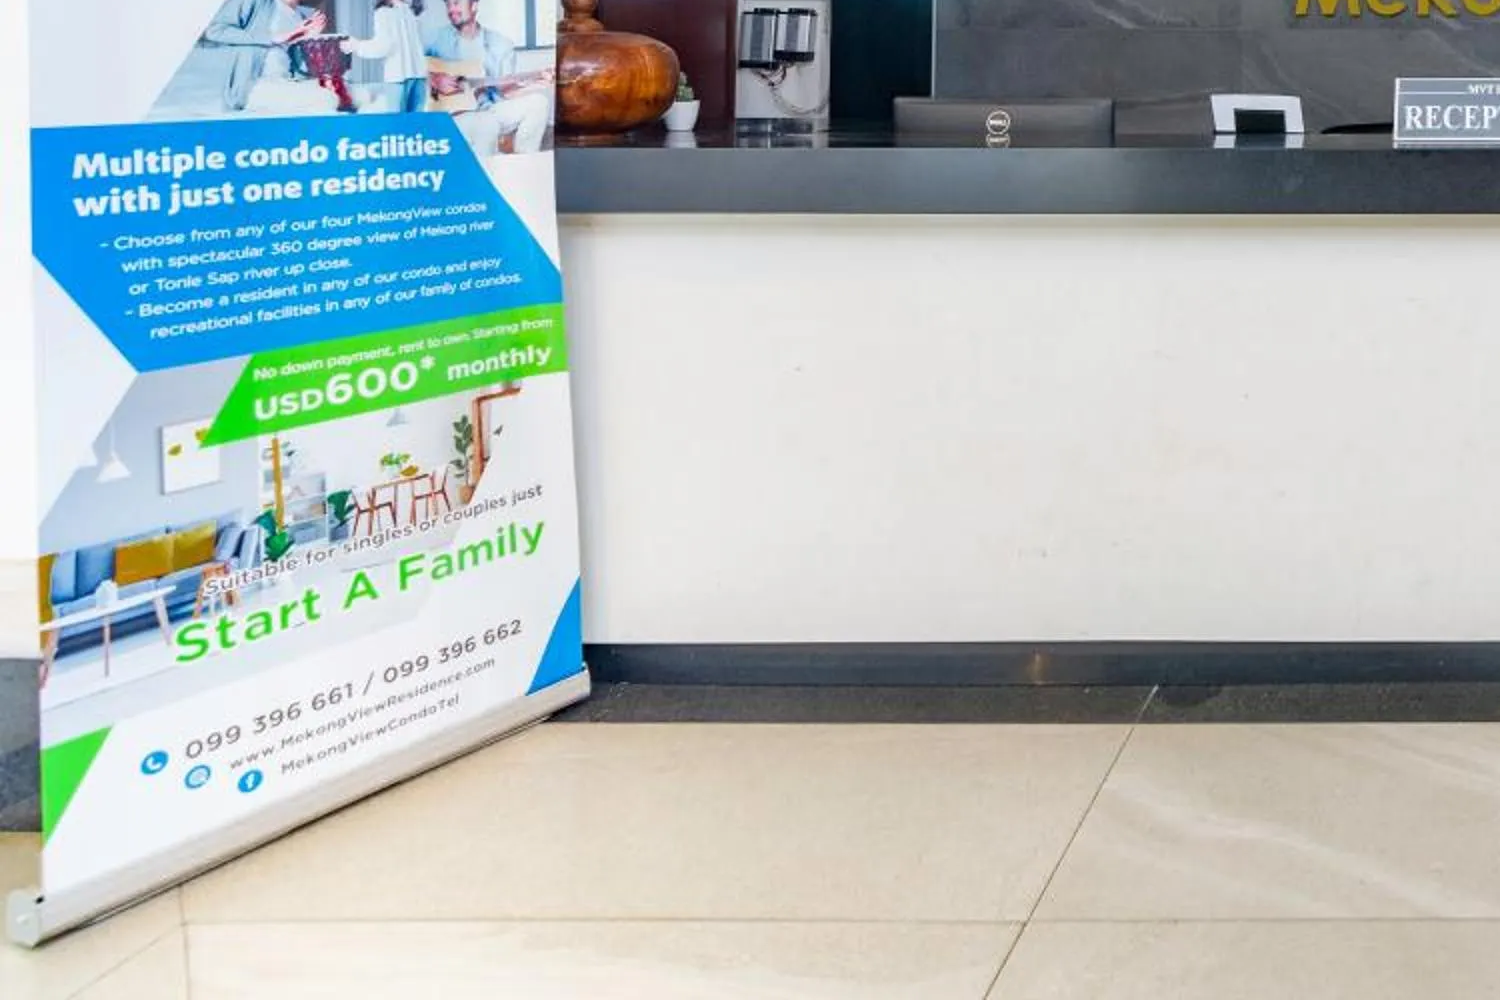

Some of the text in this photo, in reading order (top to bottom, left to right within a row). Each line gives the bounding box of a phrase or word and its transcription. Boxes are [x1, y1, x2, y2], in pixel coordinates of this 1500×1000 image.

[72, 133, 450, 180] Multiple condo facilities
[73, 168, 445, 217] with just one residency
[113, 231, 185, 250] Choose
[191, 228, 231, 242] from
[236, 224, 264, 238] any
[270, 219, 287, 234] of
[291, 218, 317, 232] our
[322, 214, 353, 229] four
[358, 204, 441, 224] MekongView
[445, 202, 487, 216] condos
[121, 219, 496, 273] with spectacular 360 degree view of Mekong river
[128, 257, 352, 296] or Tonle Sap river up close.
[139, 296, 213, 317] Become
[218, 295, 229, 306] a
[234, 283, 298, 304] resident
[303, 281, 317, 294] in
[321, 277, 349, 292] any
[354, 273, 370, 287] of
[374, 270, 398, 284] our
[401, 265, 441, 281] condo
[444, 259, 467, 274] and
[469, 256, 502, 273] enjoy
[150, 312, 253, 339] recreational
[257, 302, 320, 321] facilities
[325, 298, 339, 312] in
[343, 295, 370, 310] any
[375, 291, 392, 305] of
[394, 288, 418, 301] our
[420, 281, 456, 298] family
[460, 278, 474, 291] of
[253, 366, 278, 382] No
[280, 359, 324, 376] down
[399, 340, 425, 354] rent
[427, 336, 441, 348] to
[472, 322, 520, 339] Starting
[521, 318, 553, 331] from
[447, 344, 552, 381] monthly
[202, 484, 544, 597] Suitable for singles or couples just
[175, 521, 545, 664] Start A Family
[185, 724, 242, 759] 099
[253, 705, 302, 736] 396
[311, 682, 354, 712] 661
[383, 655, 430, 684] 099
[438, 635, 477, 665] 396
[483, 618, 522, 647] 662
